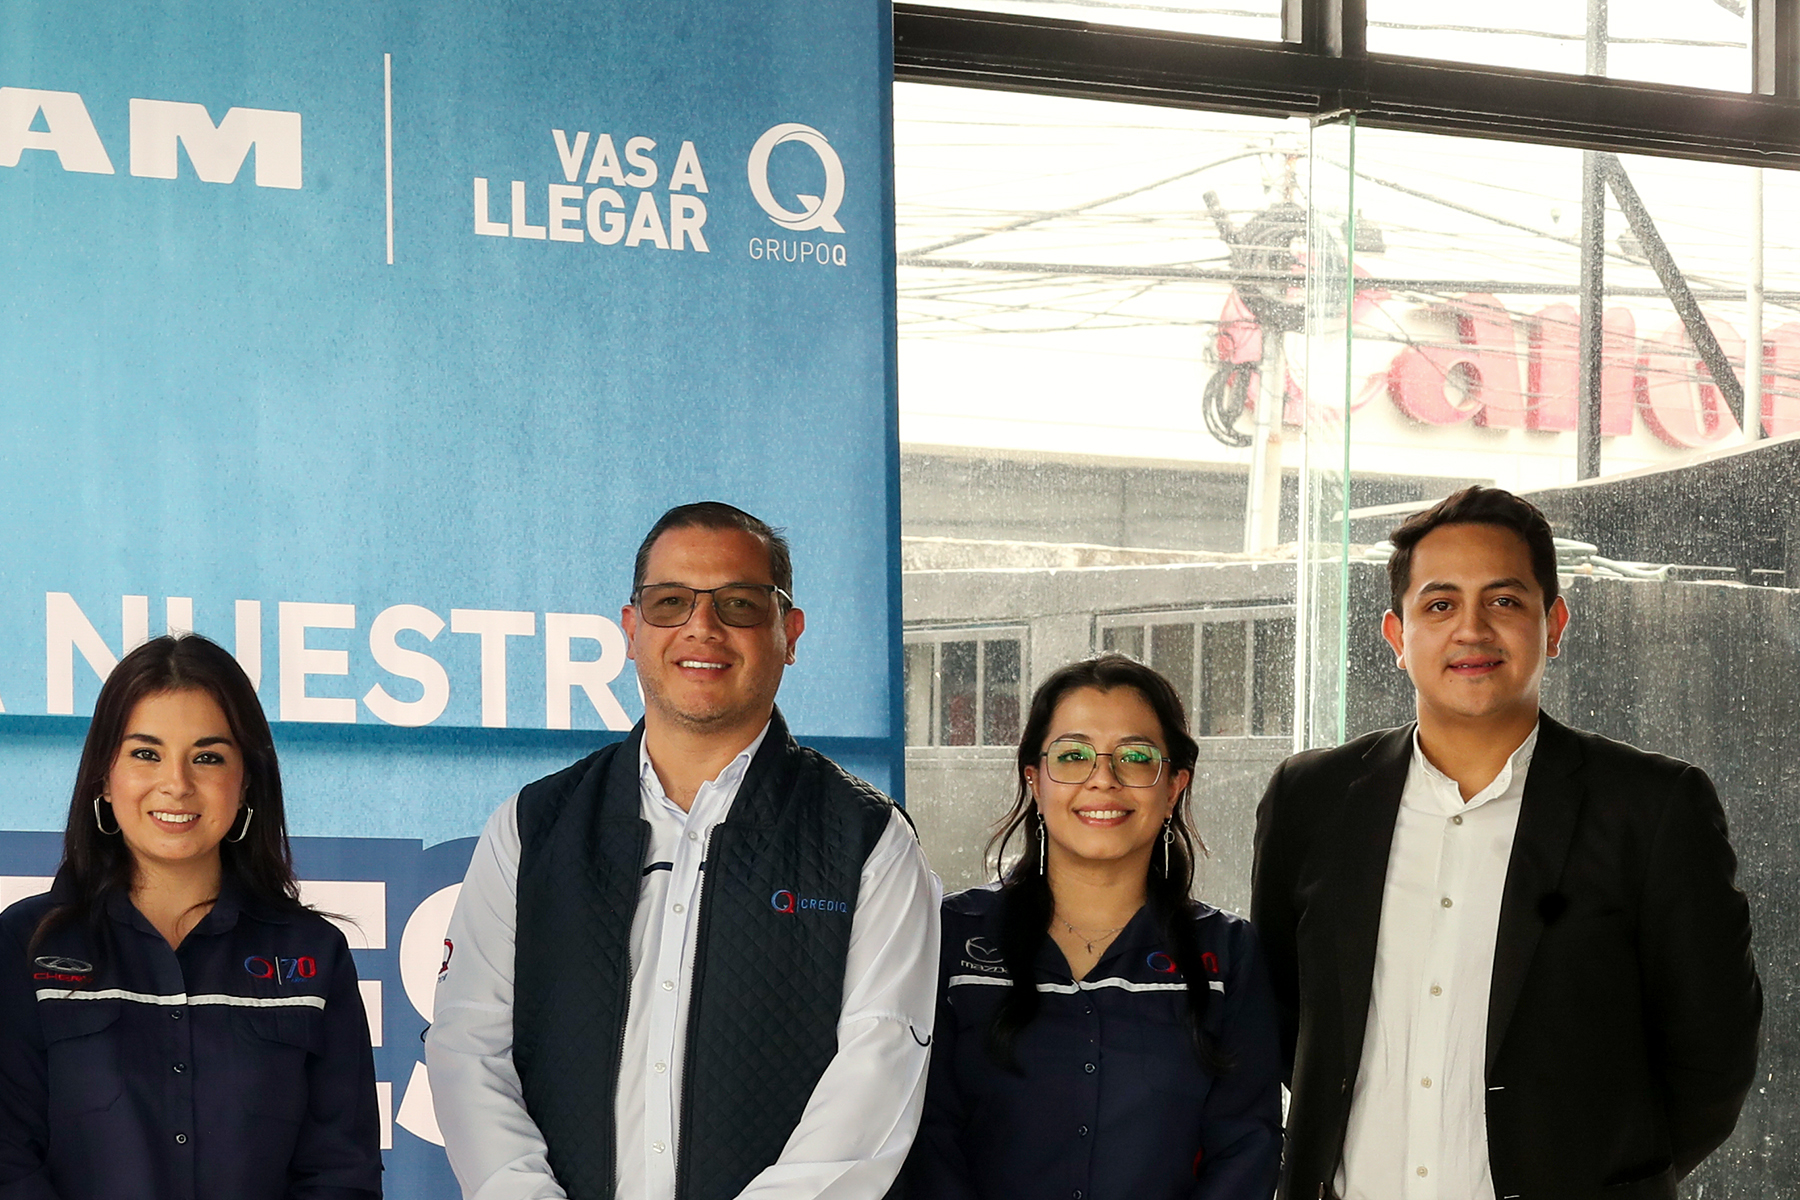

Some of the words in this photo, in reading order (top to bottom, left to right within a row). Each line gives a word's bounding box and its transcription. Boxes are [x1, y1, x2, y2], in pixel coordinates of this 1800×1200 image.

[551, 128, 659, 188] VAS
[669, 140, 709, 193] A
[473, 177, 710, 253] LLEGAR
[748, 237, 847, 266] GRUPOQ
[46, 594, 647, 732] NUESTR
[800, 898, 848, 913] CREDIQ
